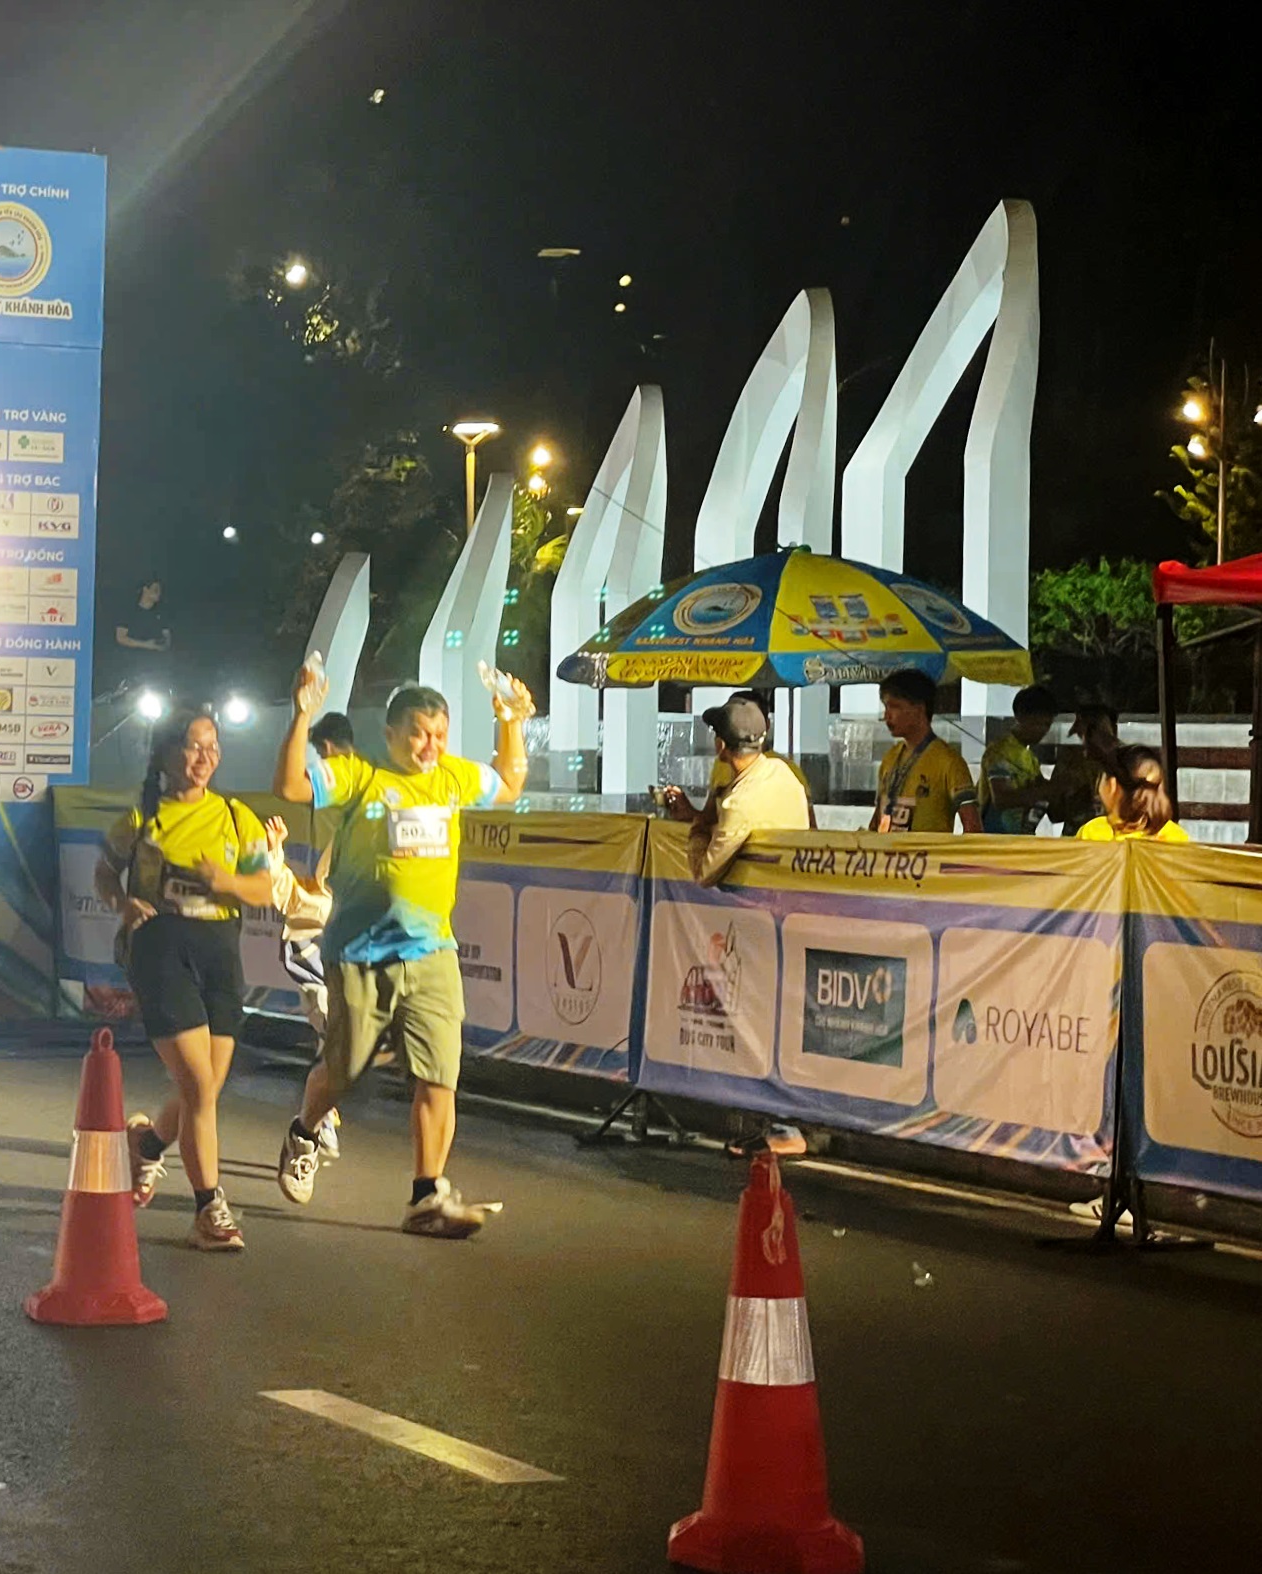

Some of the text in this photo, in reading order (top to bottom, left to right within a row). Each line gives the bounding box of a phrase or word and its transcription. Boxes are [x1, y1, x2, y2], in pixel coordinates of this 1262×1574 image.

[1, 183, 27, 198] TRỢ
[29, 184, 70, 199] CHÍNH
[4, 298, 44, 315] KHÁNH
[47, 299, 71, 317] HÒA
[3, 409, 29, 422] TRỢ
[31, 409, 67, 423] VÀNG
[791, 843, 928, 888] NHÀ TÀI TRỢ
[818, 968, 872, 1010] BIDV
[986, 1005, 1091, 1054] ROYABE
